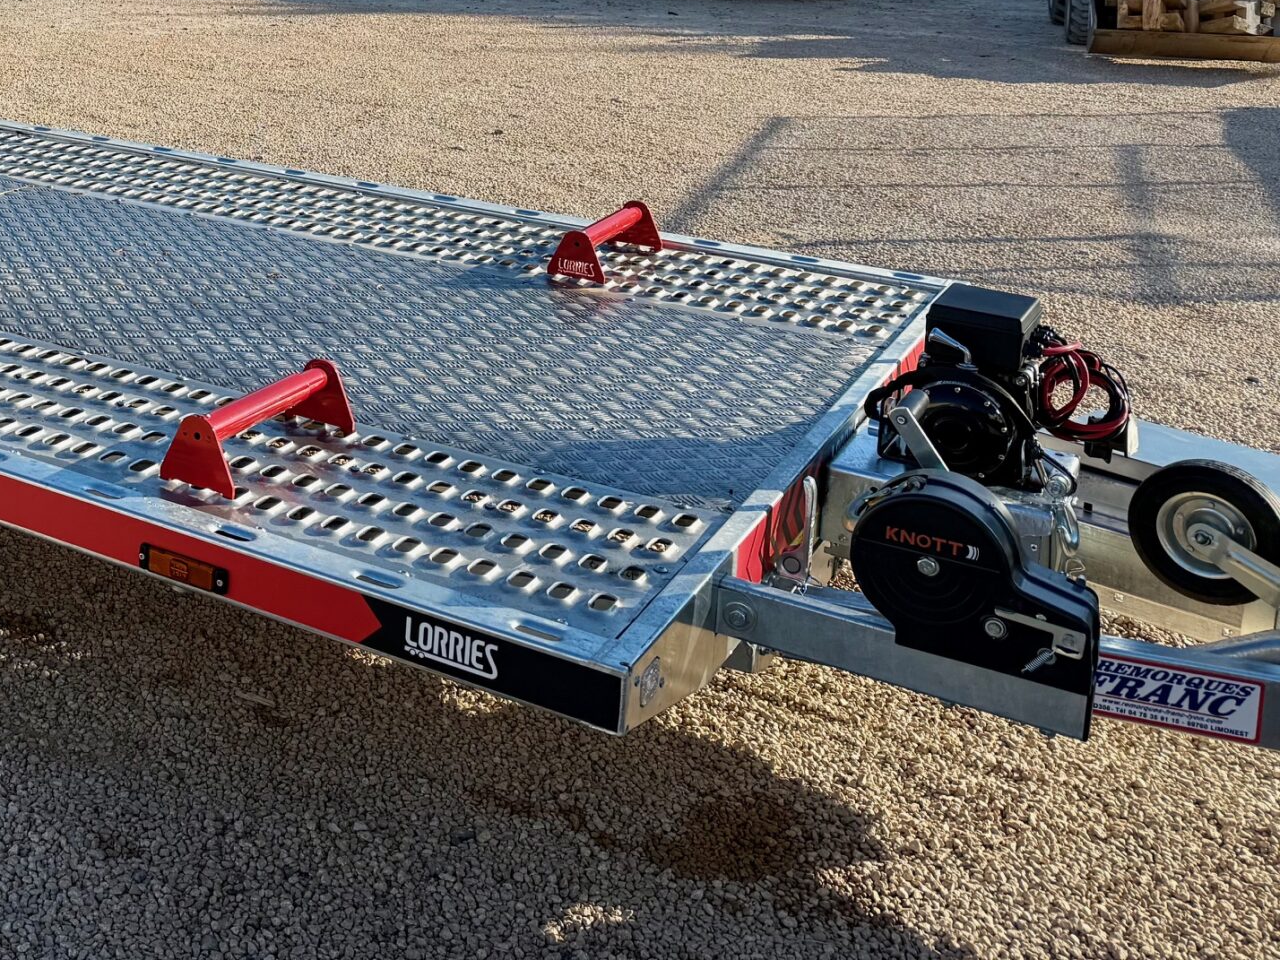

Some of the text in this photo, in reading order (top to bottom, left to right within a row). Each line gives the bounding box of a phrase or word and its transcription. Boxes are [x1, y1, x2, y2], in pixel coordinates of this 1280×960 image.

[558, 257, 595, 277] LORRIES
[885, 526, 964, 556] KNOTT
[403, 616, 499, 680] LORRIES
[1094, 671, 1246, 718] FRANC
[1097, 659, 1255, 697] REMORQUES
[1210, 725, 1249, 737] LIMONEST
